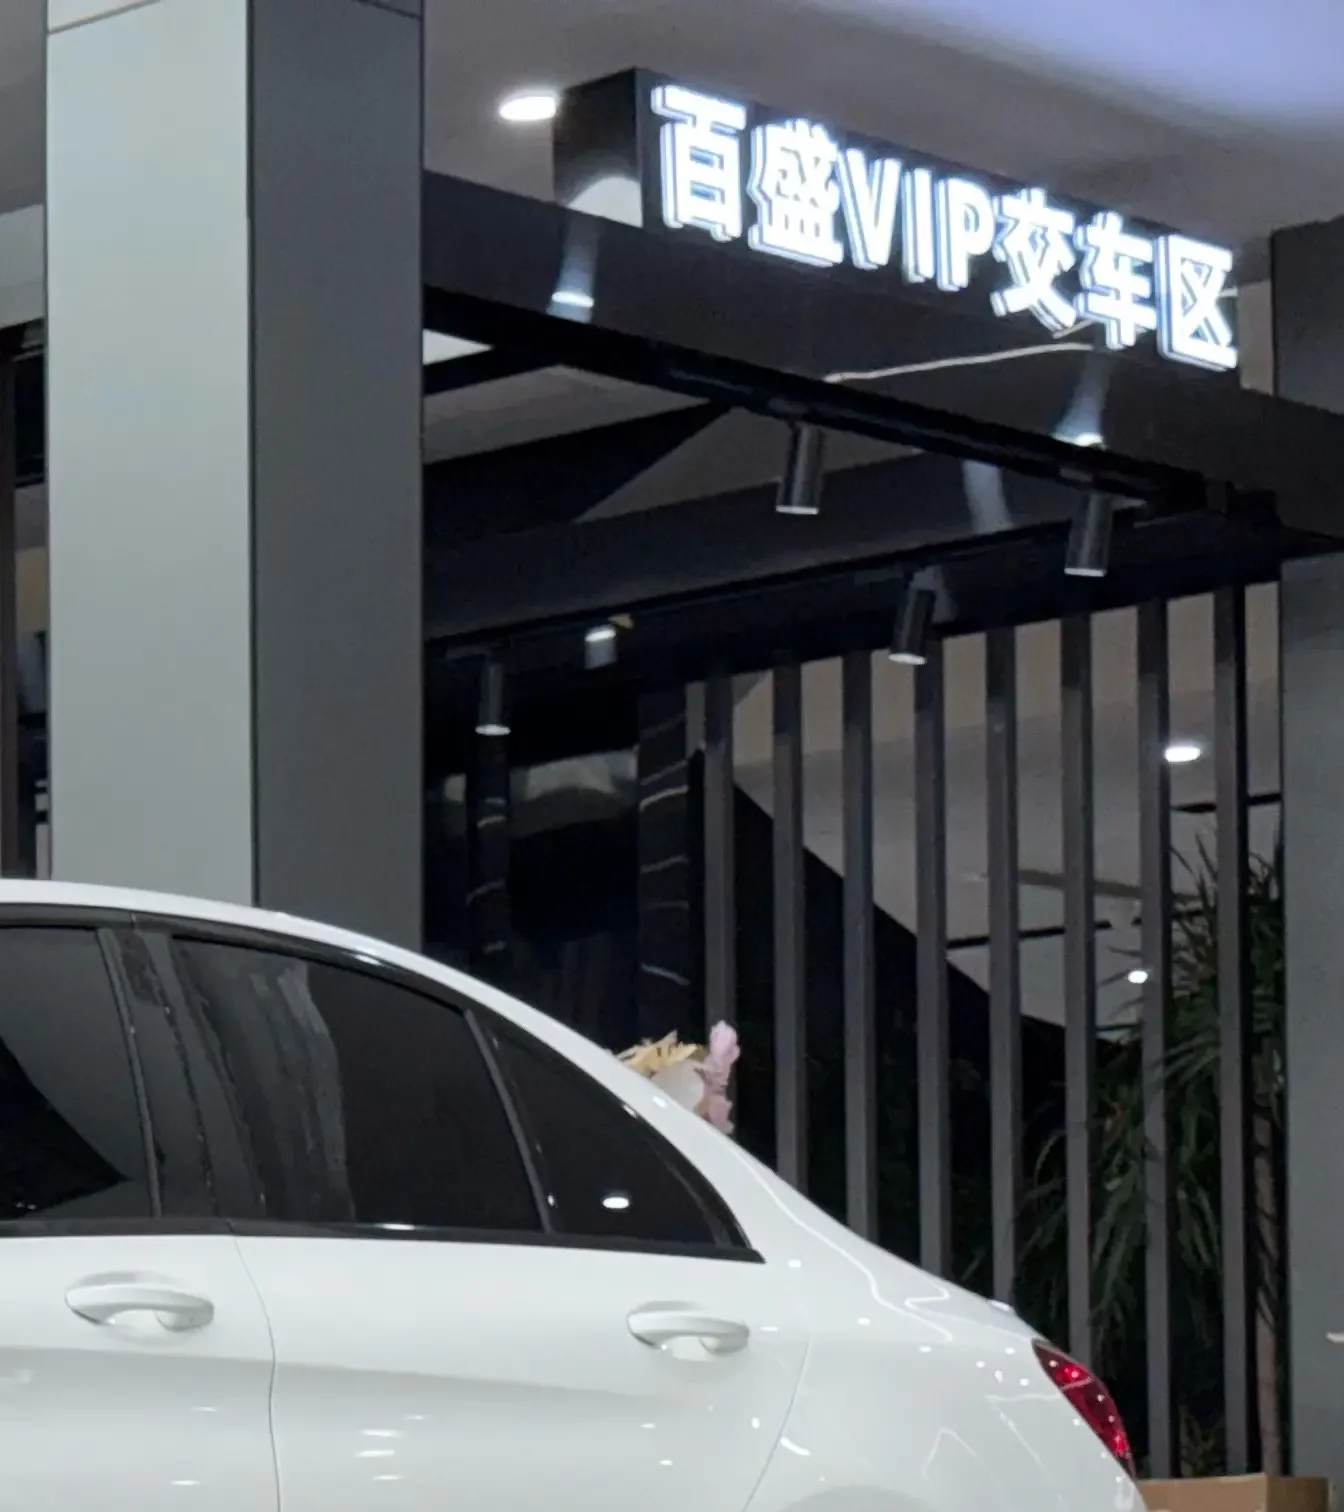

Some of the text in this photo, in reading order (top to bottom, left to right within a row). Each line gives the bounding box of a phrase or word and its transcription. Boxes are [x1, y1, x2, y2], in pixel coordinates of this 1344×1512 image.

[651, 84, 1239, 371] 百盛VIP交车区
